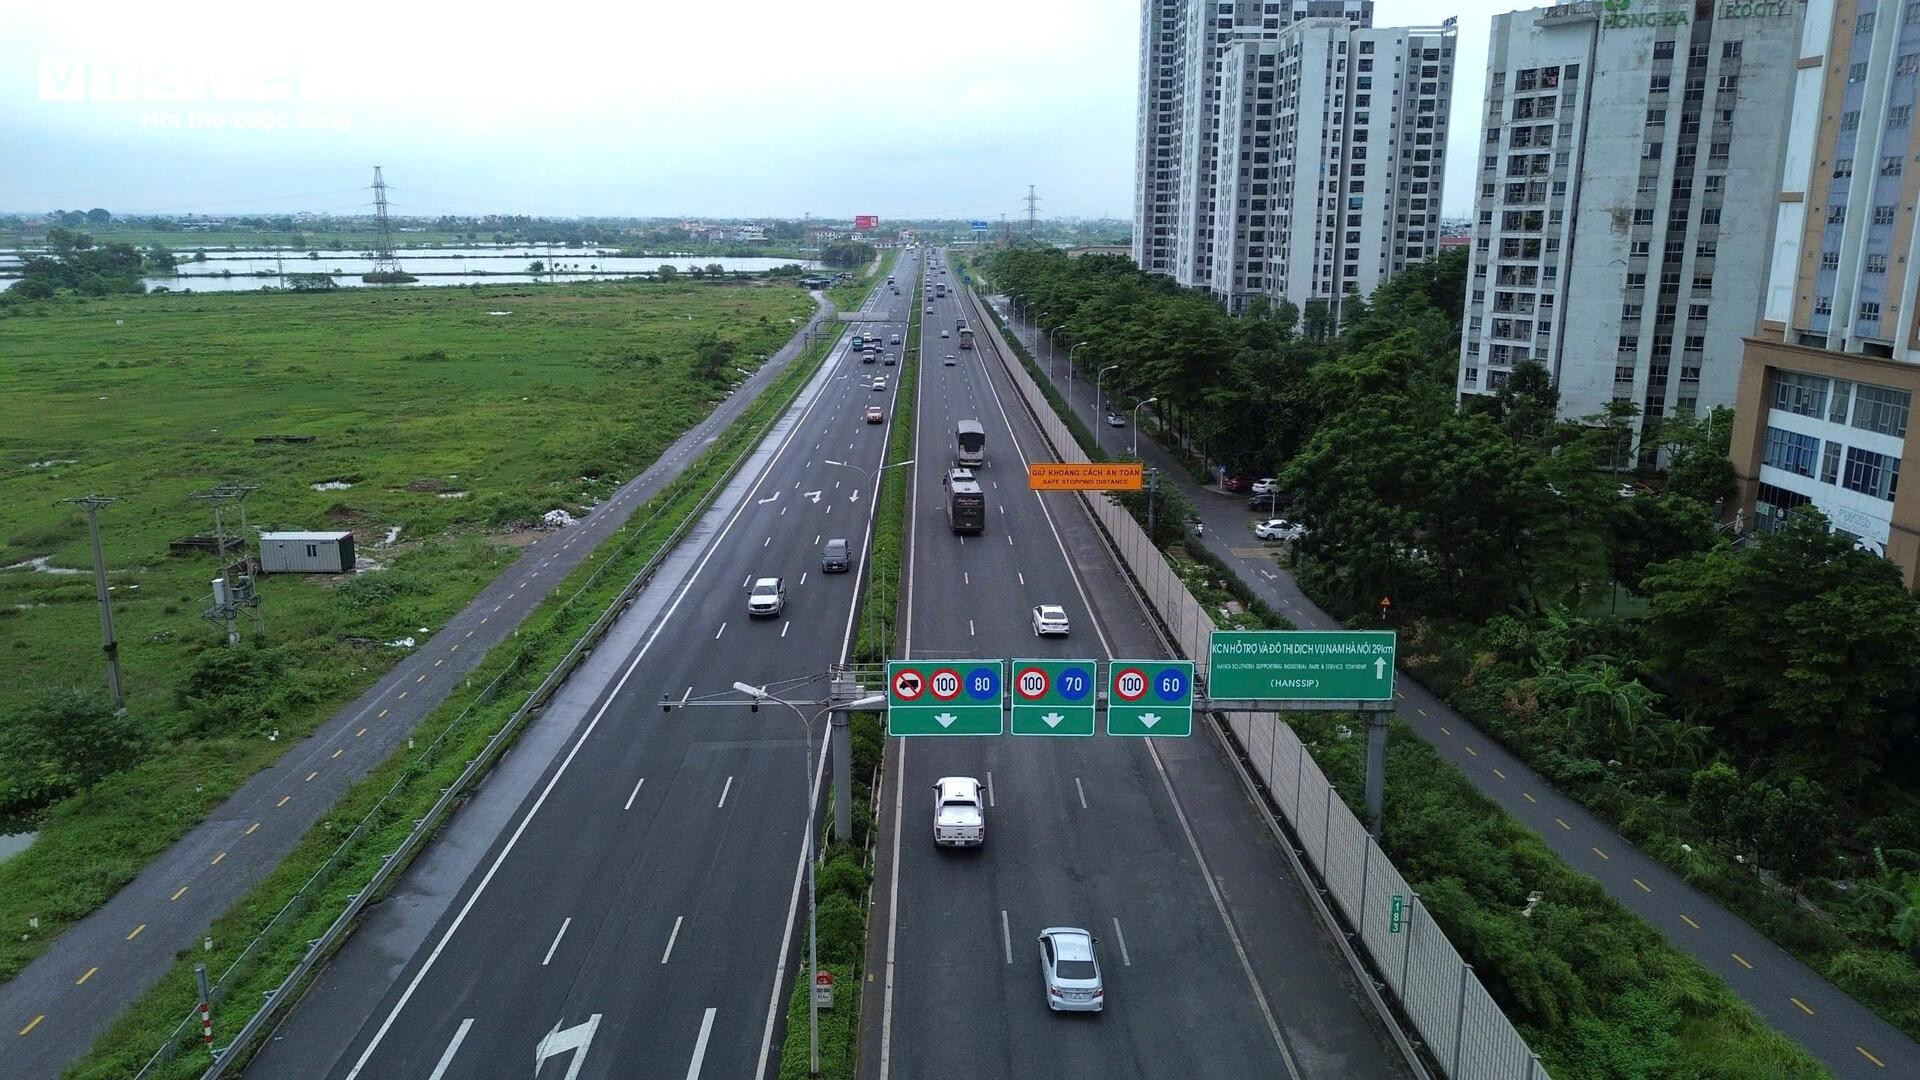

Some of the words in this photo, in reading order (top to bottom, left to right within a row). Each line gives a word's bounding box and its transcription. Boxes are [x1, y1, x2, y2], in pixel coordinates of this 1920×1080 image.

[1082, 467, 1103, 476] CÁCH
[1119, 467, 1140, 476] TOÀN
[1212, 643, 1229, 653] KCN
[1259, 640, 1269, 653] VÀ
[1269, 641, 1282, 653] ĐÔ
[1294, 643, 1314, 655] DỊCH
[1326, 643, 1345, 654] NAM
[1345, 641, 1357, 654] HÀ
[1357, 641, 1371, 655] NỘI
[934, 676, 956, 692] 100
[974, 677, 990, 692] 80
[1022, 675, 1043, 691] 100
[1066, 676, 1082, 692] 70
[1121, 677, 1142, 692] 100
[1162, 677, 1180, 692] 60
[1270, 679, 1319, 688] (HANSSIP)
